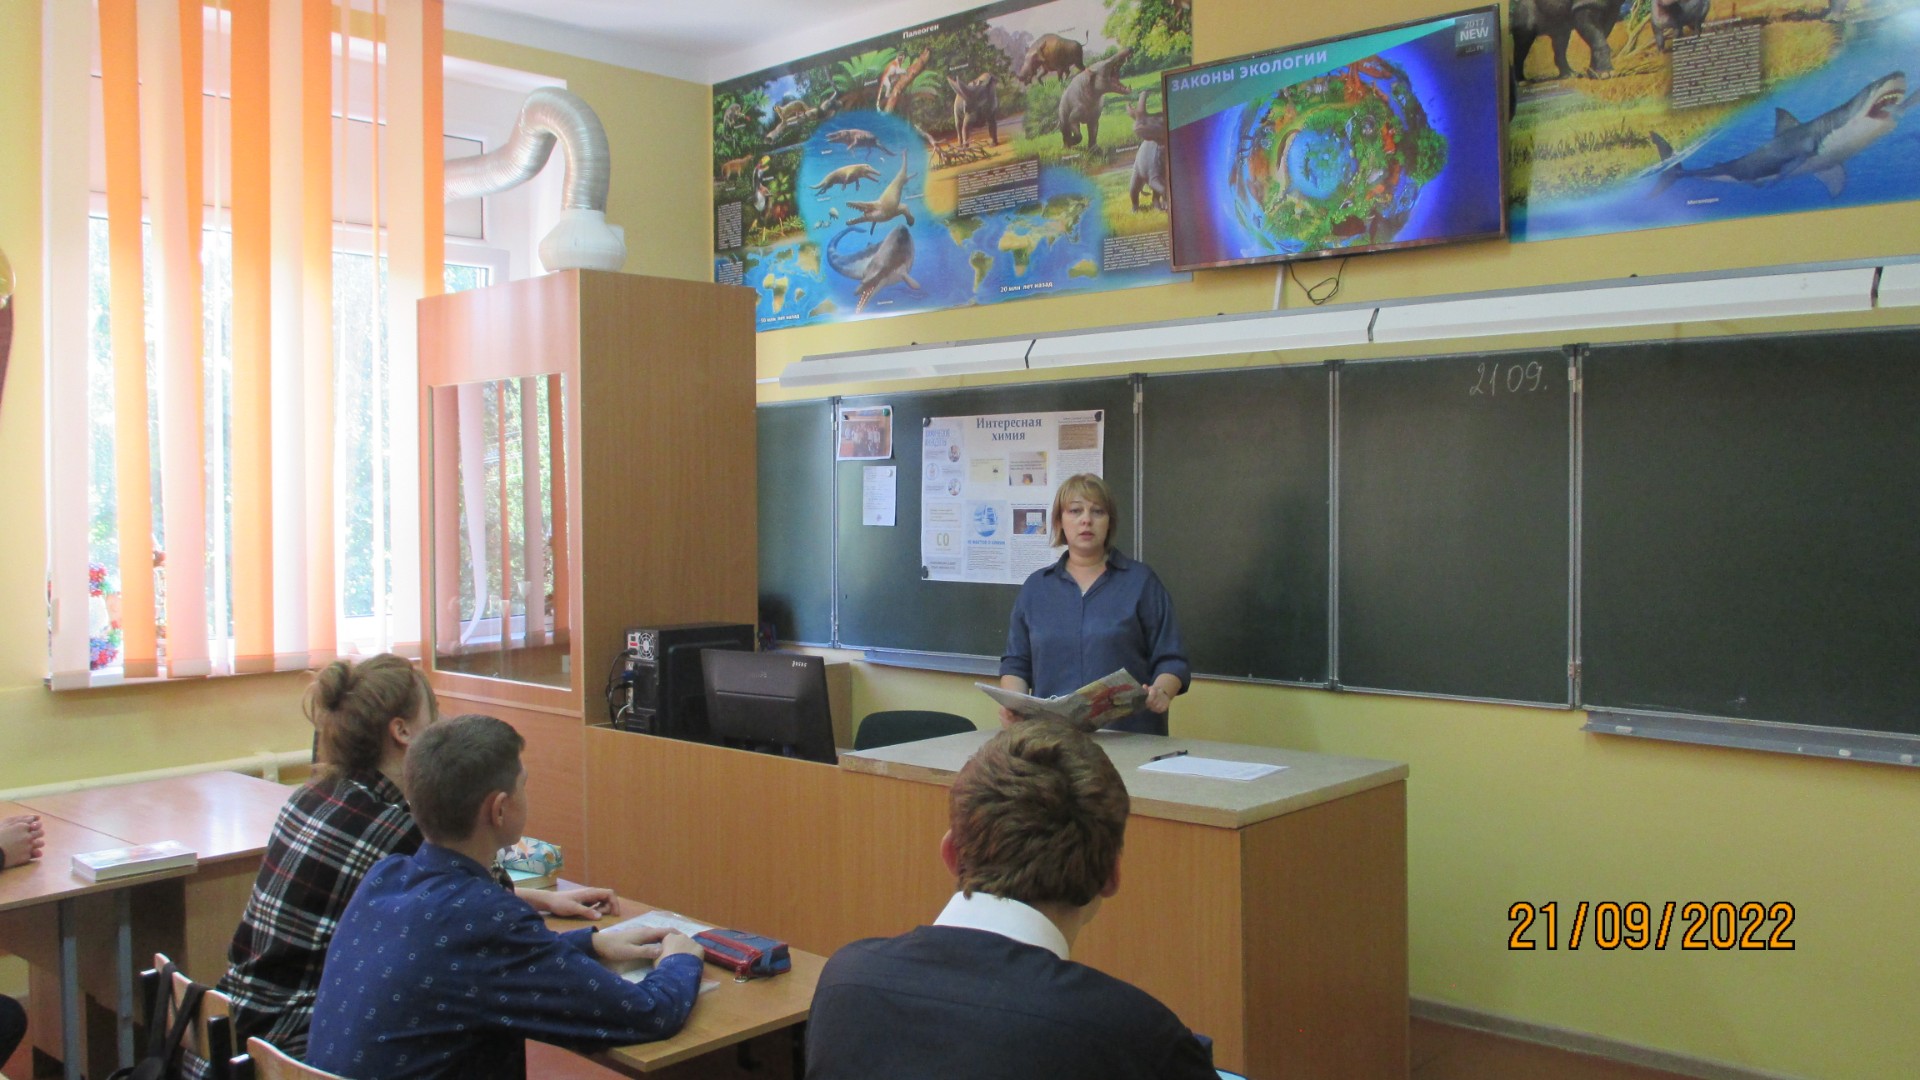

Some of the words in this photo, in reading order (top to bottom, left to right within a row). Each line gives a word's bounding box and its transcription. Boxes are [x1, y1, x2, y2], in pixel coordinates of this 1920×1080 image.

[902, 23, 940, 40] Палеоген
[1460, 26, 1489, 42] NEW
[1171, 68, 1235, 92] ЗАКОНЫ
[1239, 50, 1328, 79] ЭКОЛОГИИ
[976, 417, 1042, 432] Интересная
[992, 431, 1026, 442] химия
